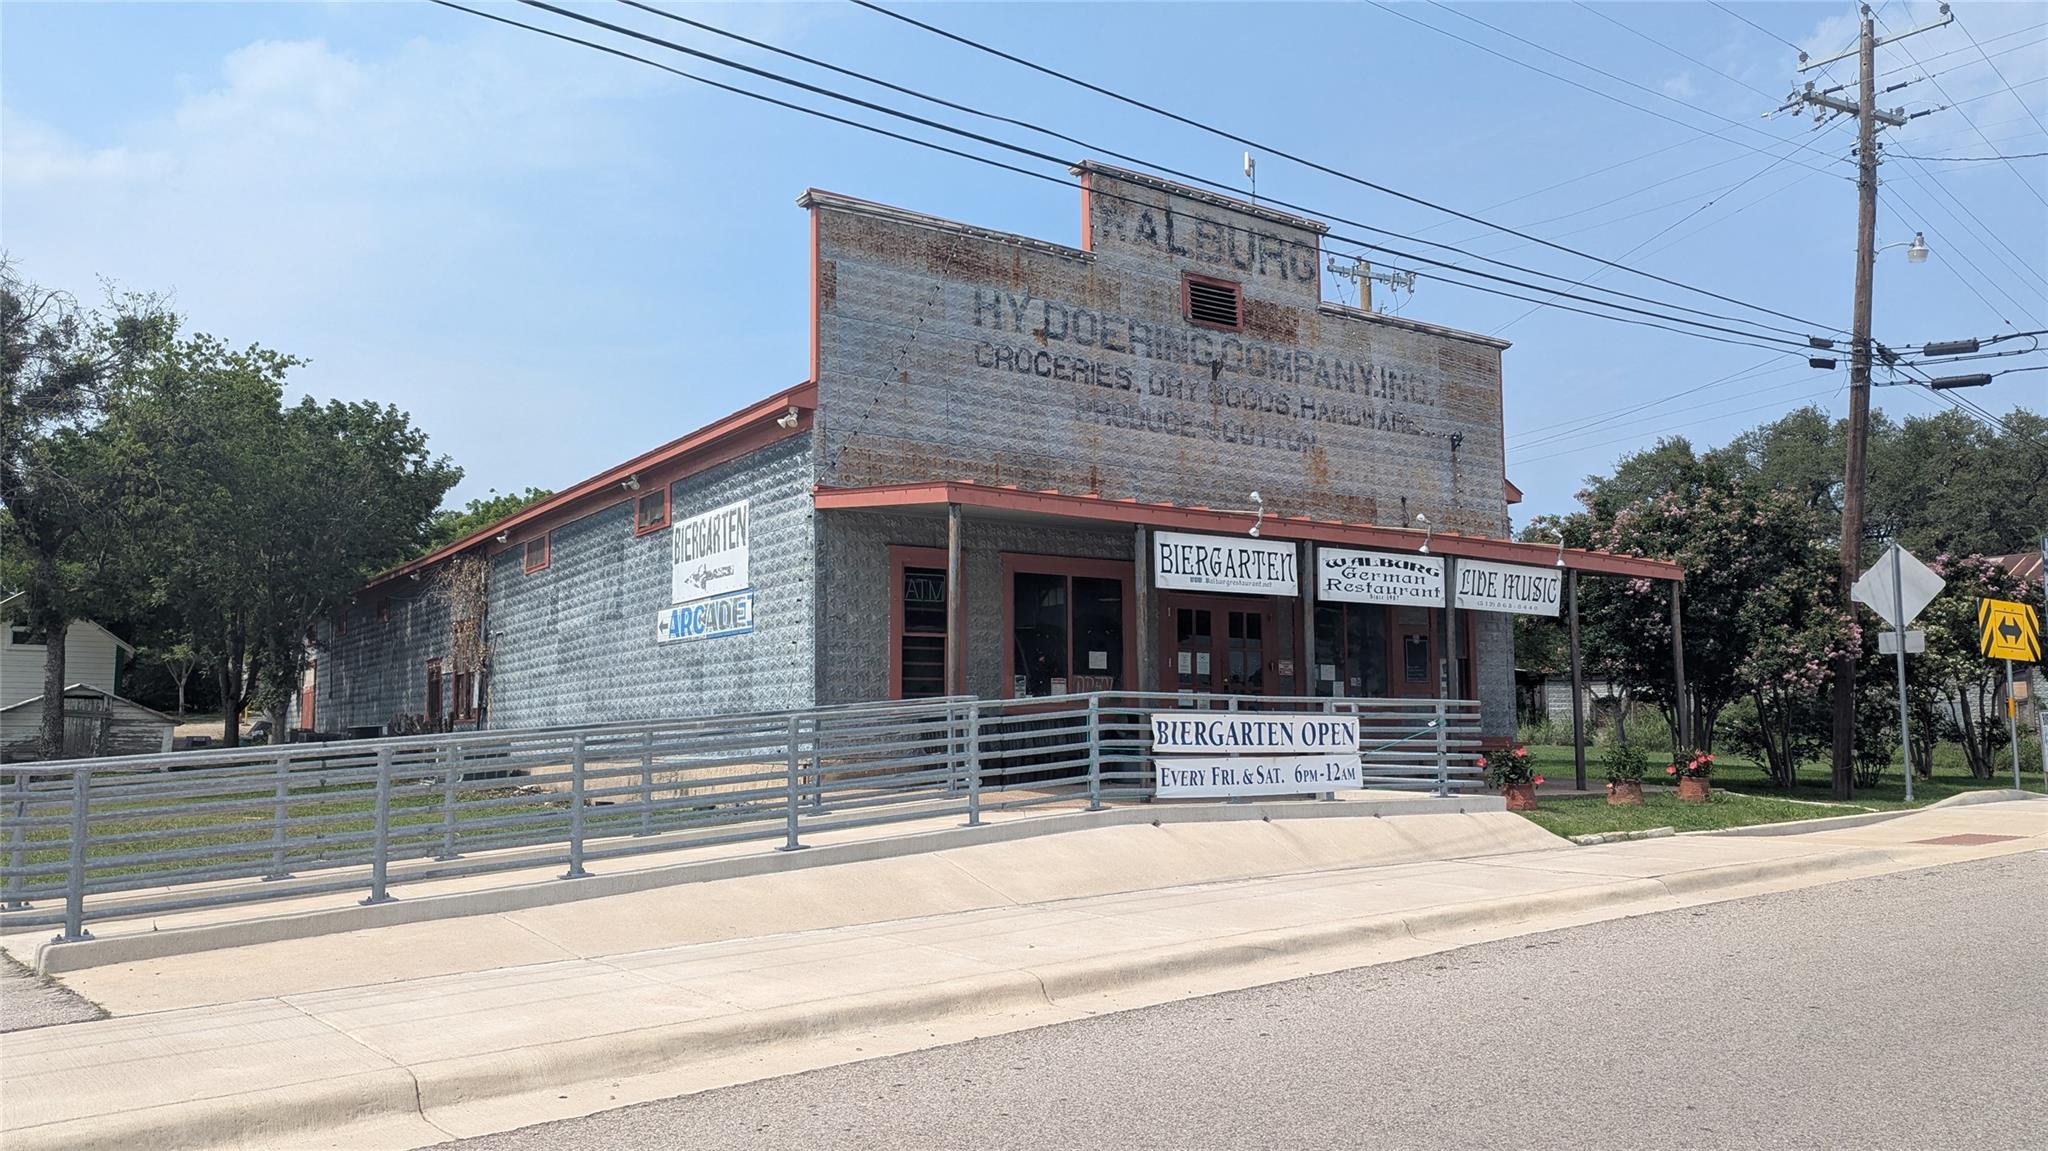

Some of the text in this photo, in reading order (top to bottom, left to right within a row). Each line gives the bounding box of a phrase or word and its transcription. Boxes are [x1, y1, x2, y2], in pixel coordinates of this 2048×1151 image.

[674, 505, 747, 565] BIERGARTEN
[1159, 543, 1295, 582] BIERGARTEN
[1325, 557, 1440, 577] WALBURG
[1326, 578, 1440, 598] Restaurant
[1342, 567, 1425, 585] German
[1459, 569, 1558, 603] LIVE MUSIC
[905, 578, 944, 600] ATM
[669, 597, 746, 639] ARCADE
[1156, 720, 1355, 746] BIERGARTEN OPEN
[1160, 767, 1206, 787] EVERY
[1242, 769, 1253, 784] &
